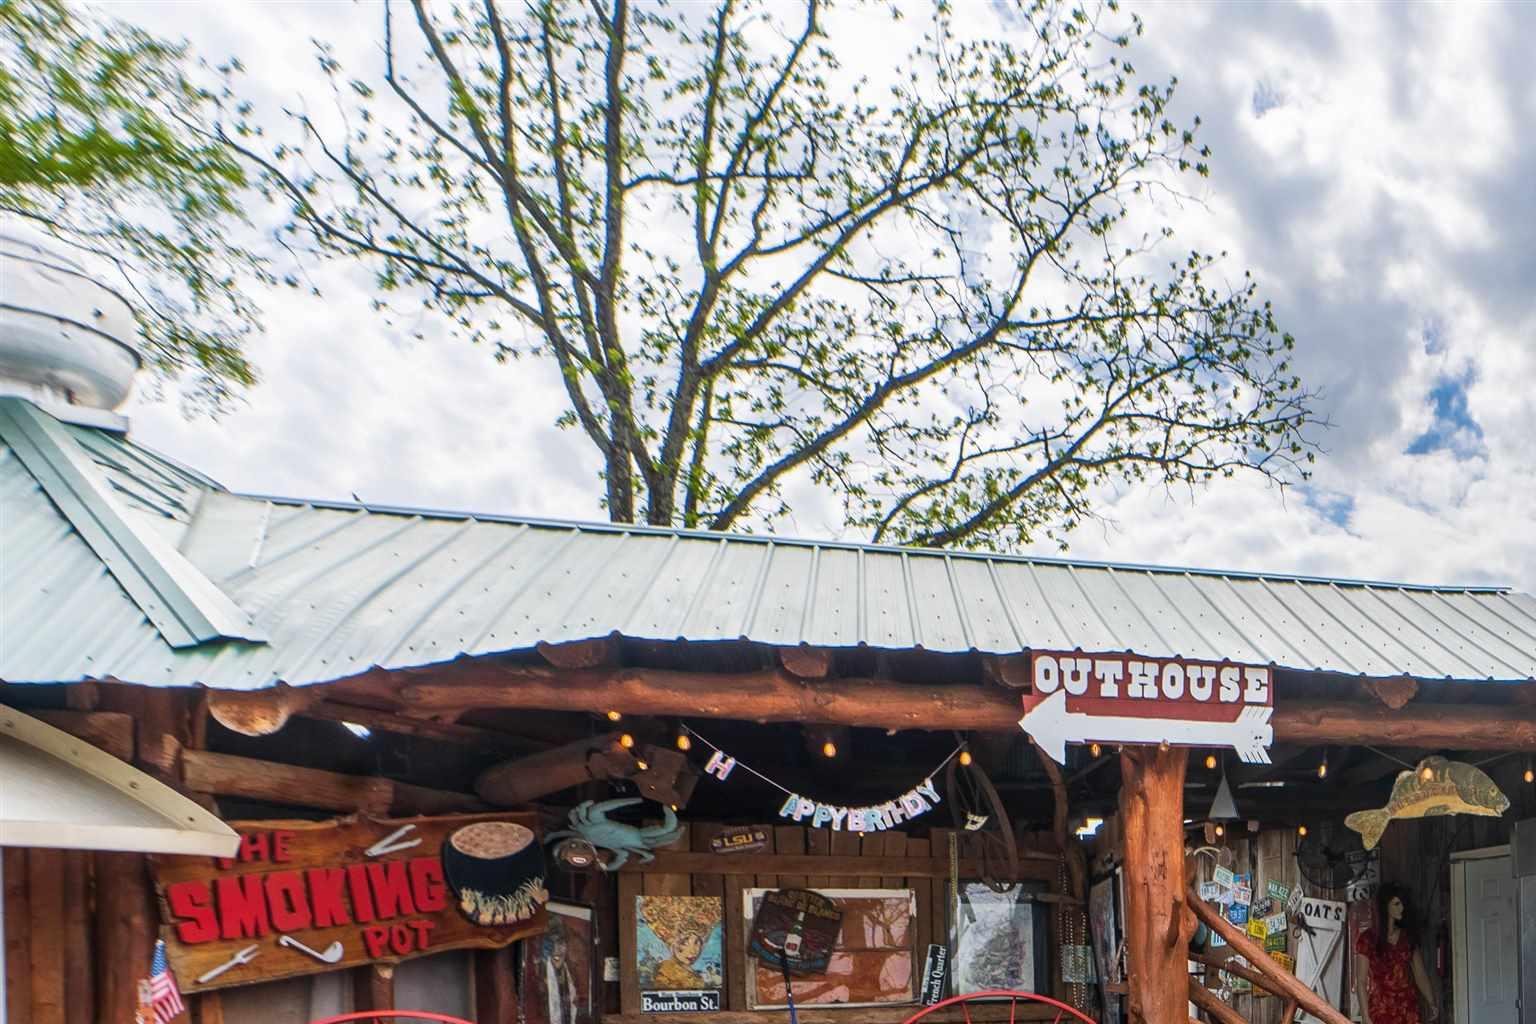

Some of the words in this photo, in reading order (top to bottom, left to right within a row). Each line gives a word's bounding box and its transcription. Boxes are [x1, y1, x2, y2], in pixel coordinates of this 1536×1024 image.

[1034, 655, 1268, 703] OUTHOUSE
[723, 833, 752, 848] LSU
[168, 857, 447, 944] SMOKING
[1305, 902, 1343, 921] OATS
[365, 920, 436, 958] POT
[931, 946, 947, 978] Quarter
[643, 996, 697, 1011] Bourbon
[700, 996, 719, 1010] St.
